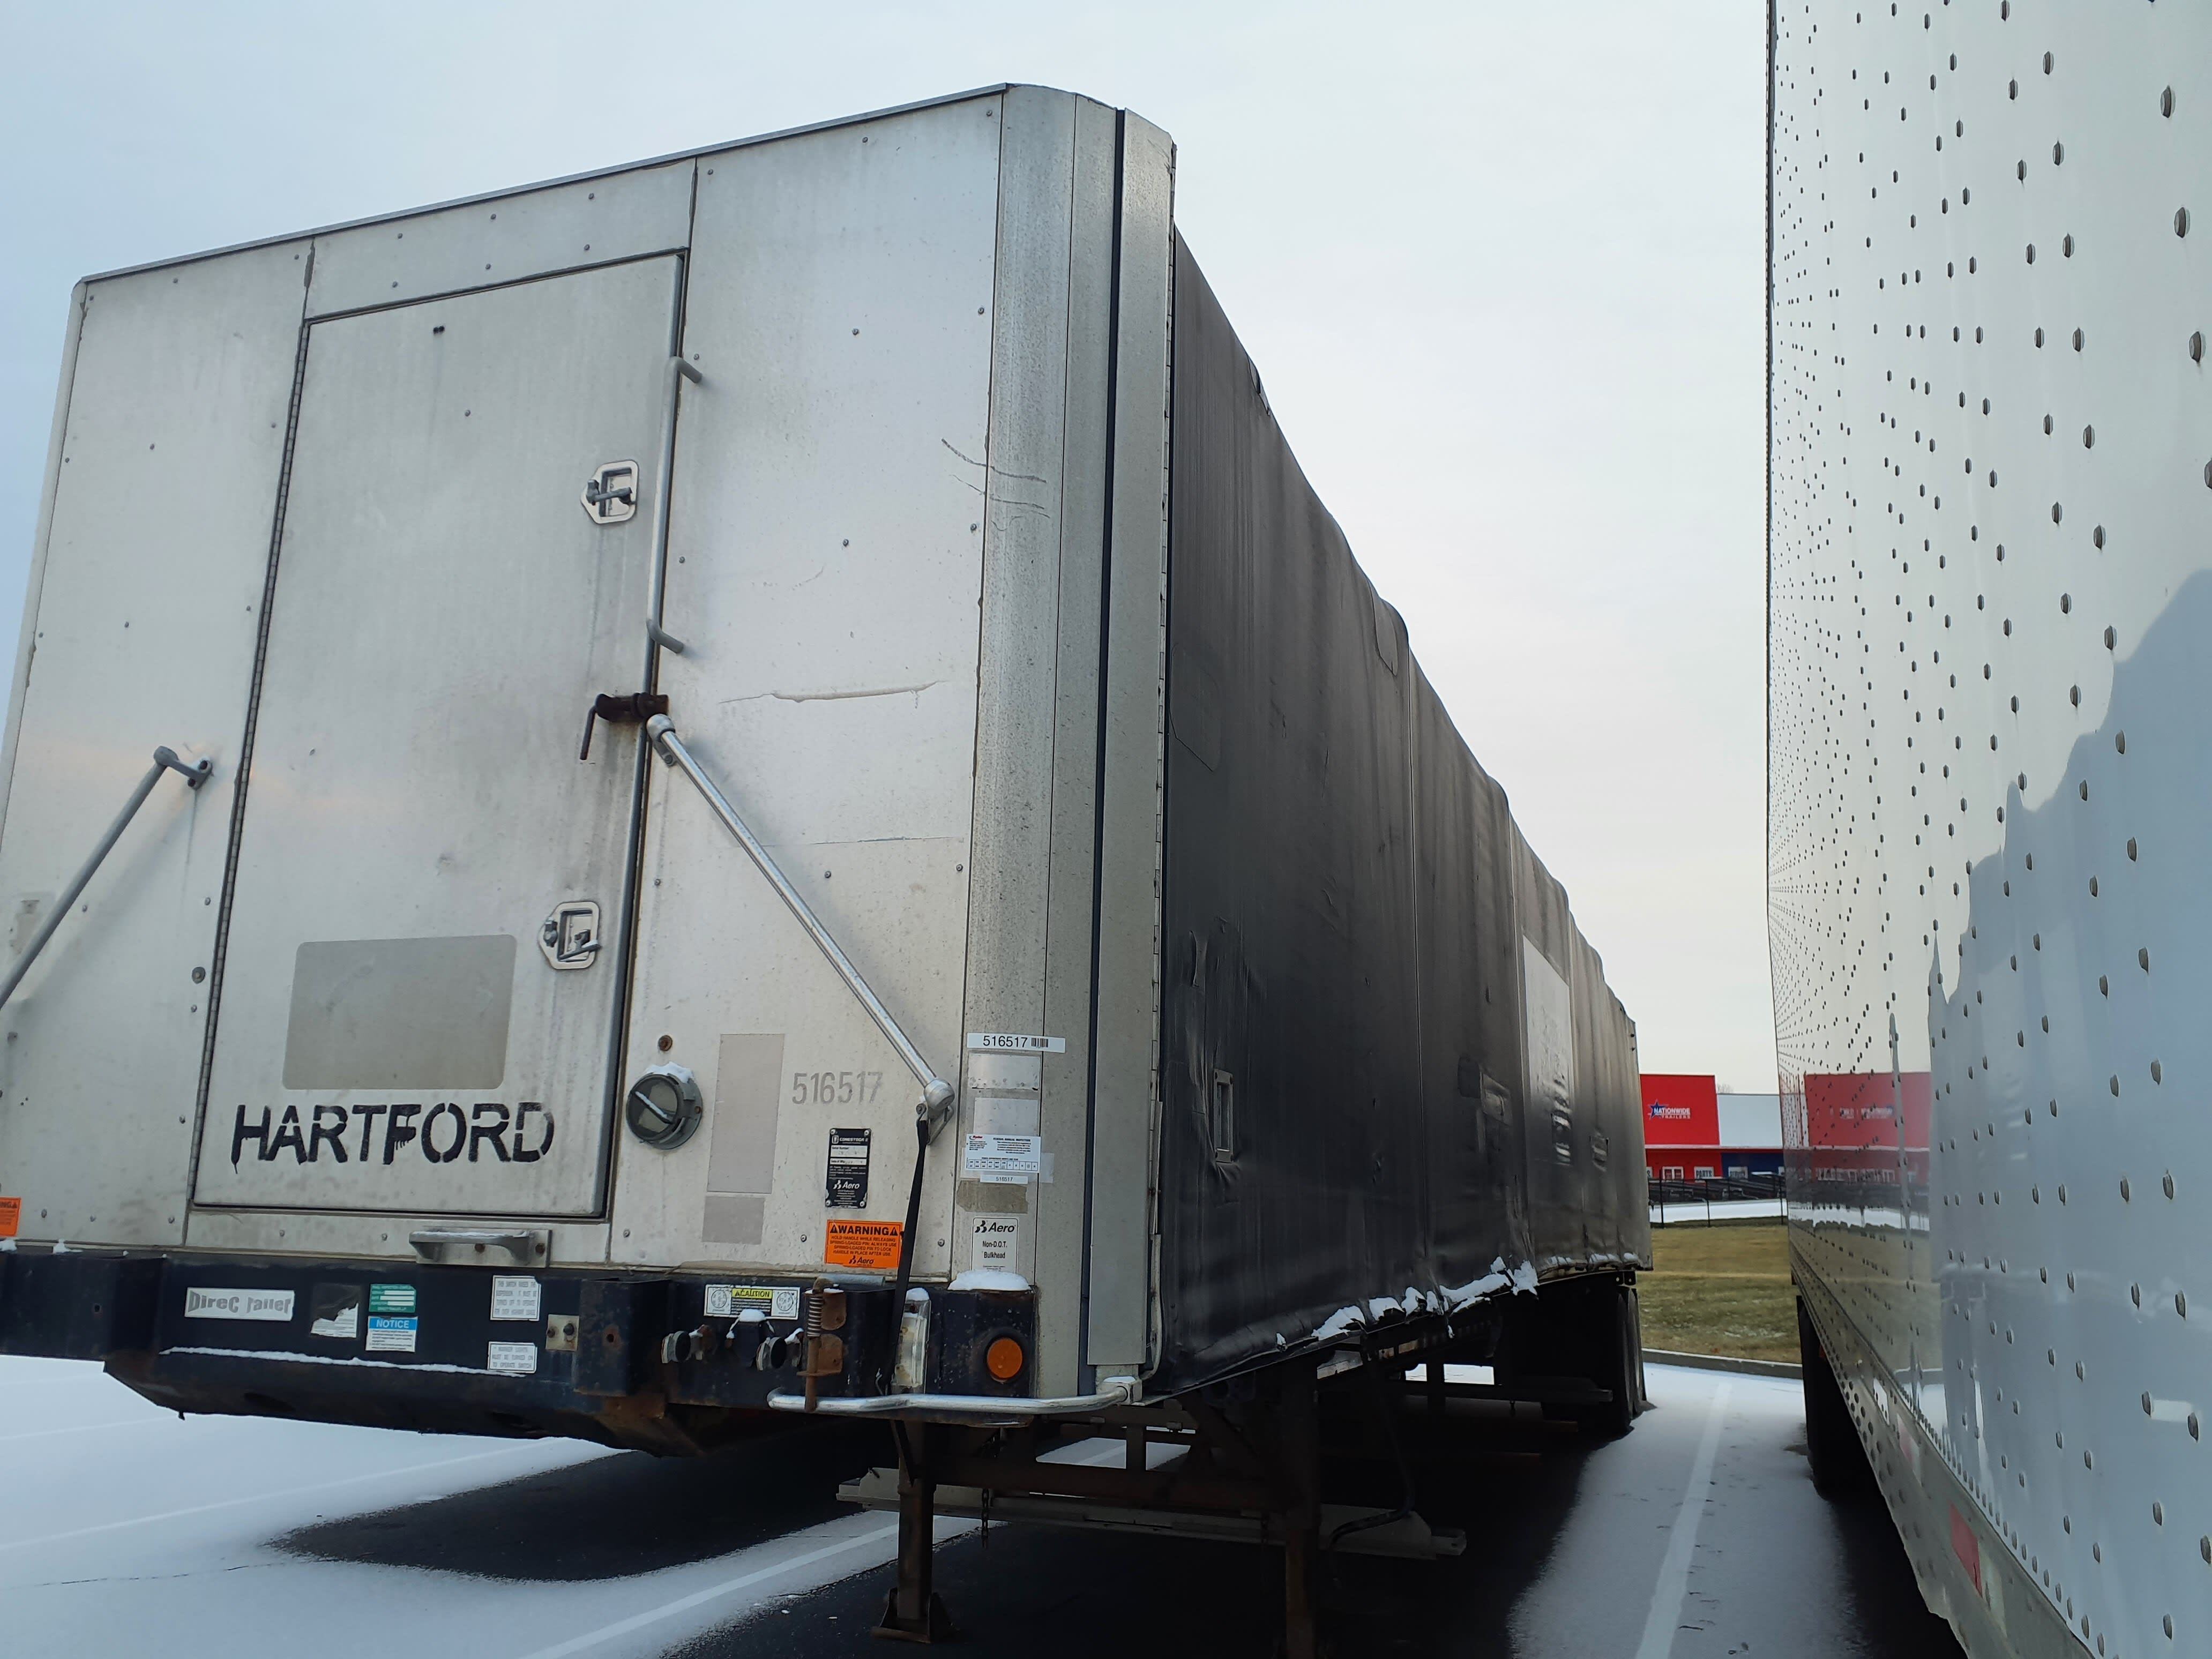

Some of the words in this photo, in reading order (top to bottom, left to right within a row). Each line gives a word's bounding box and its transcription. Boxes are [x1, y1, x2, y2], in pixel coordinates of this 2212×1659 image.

[983, 1035, 1028, 1048] 516517
[792, 1071, 883, 1104] 516517
[231, 1102, 554, 1166] HARTFORD
[842, 1181, 860, 1189] Aero
[838, 1225, 889, 1235] WARNING
[988, 1222, 1015, 1232] Aero
[738, 1289, 770, 1297] CAUTION
[376, 1319, 409, 1329] NOTICE
